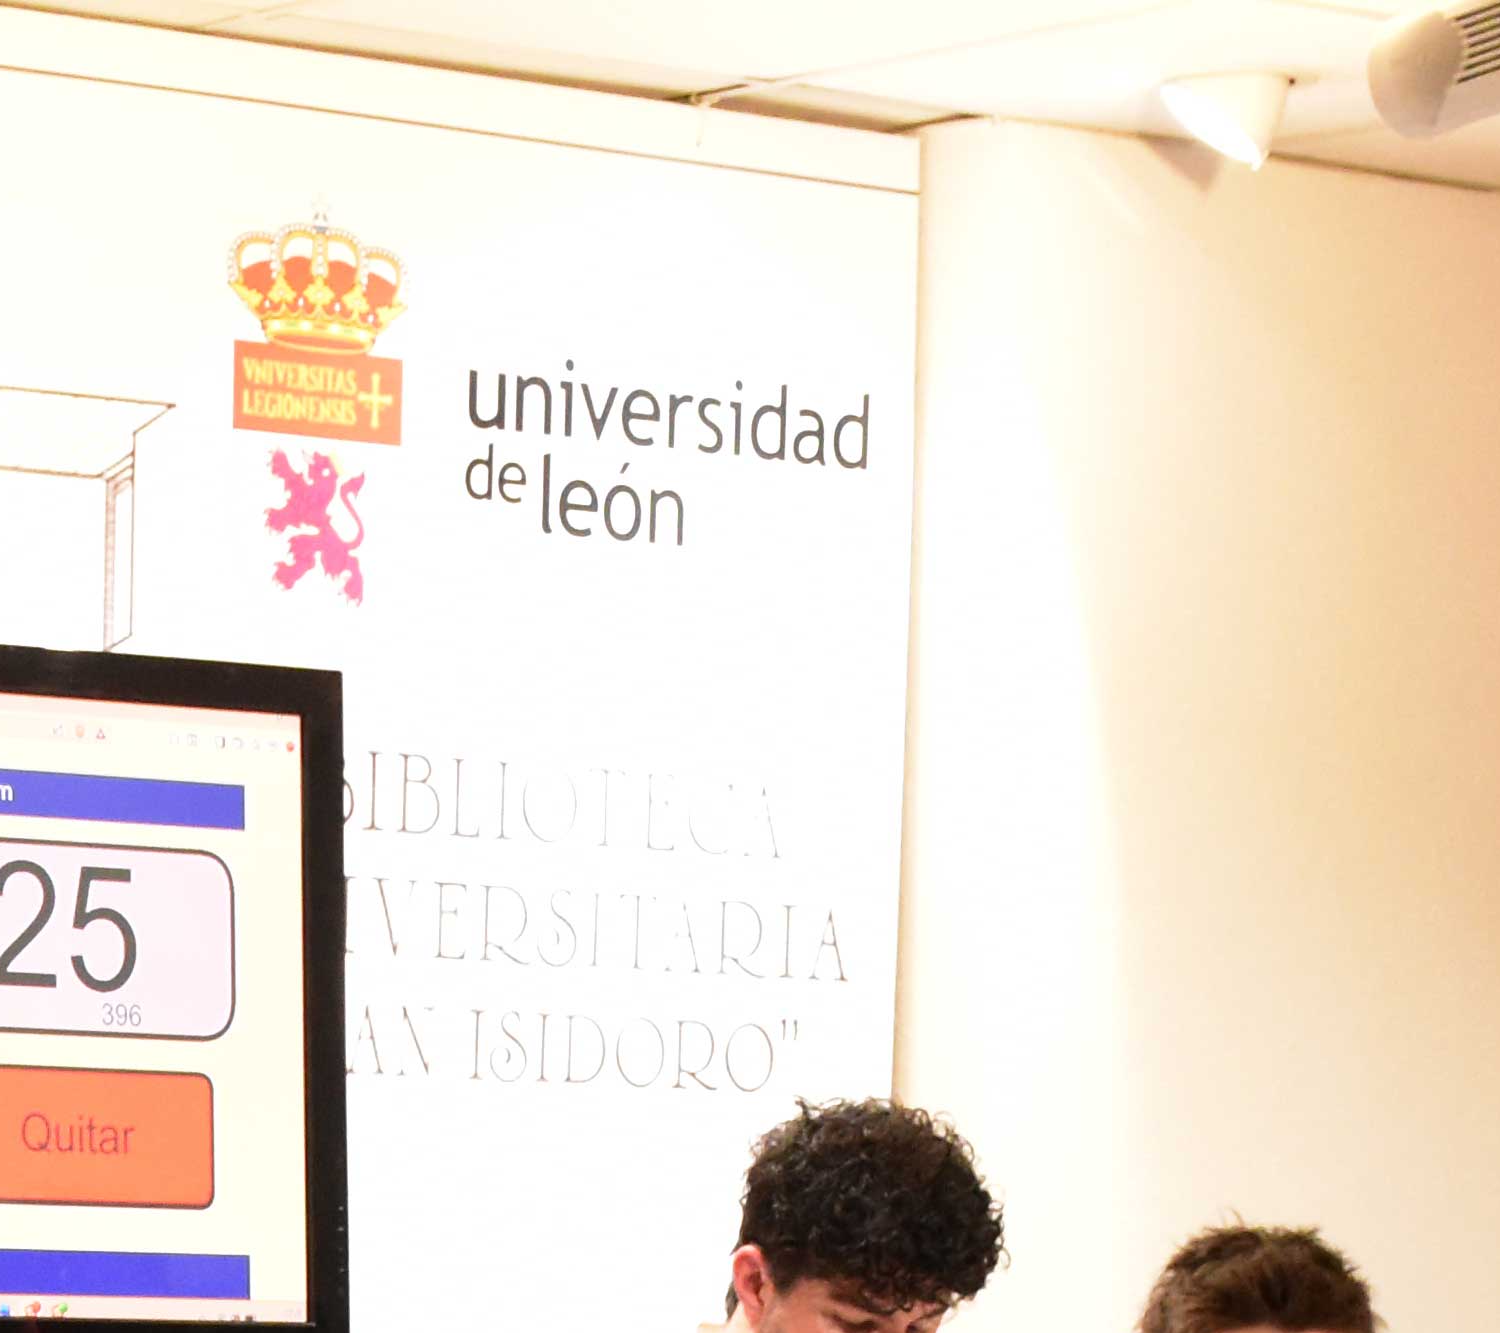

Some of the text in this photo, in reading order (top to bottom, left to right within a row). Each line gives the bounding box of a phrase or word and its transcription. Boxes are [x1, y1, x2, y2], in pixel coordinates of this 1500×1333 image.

[468, 359, 870, 470] universidad
[464, 444, 685, 546] de león
[342, 750, 781, 859] IBLIOTECA
[101, 1002, 143, 1027] 396
[21, 1112, 136, 1155] Quitar
